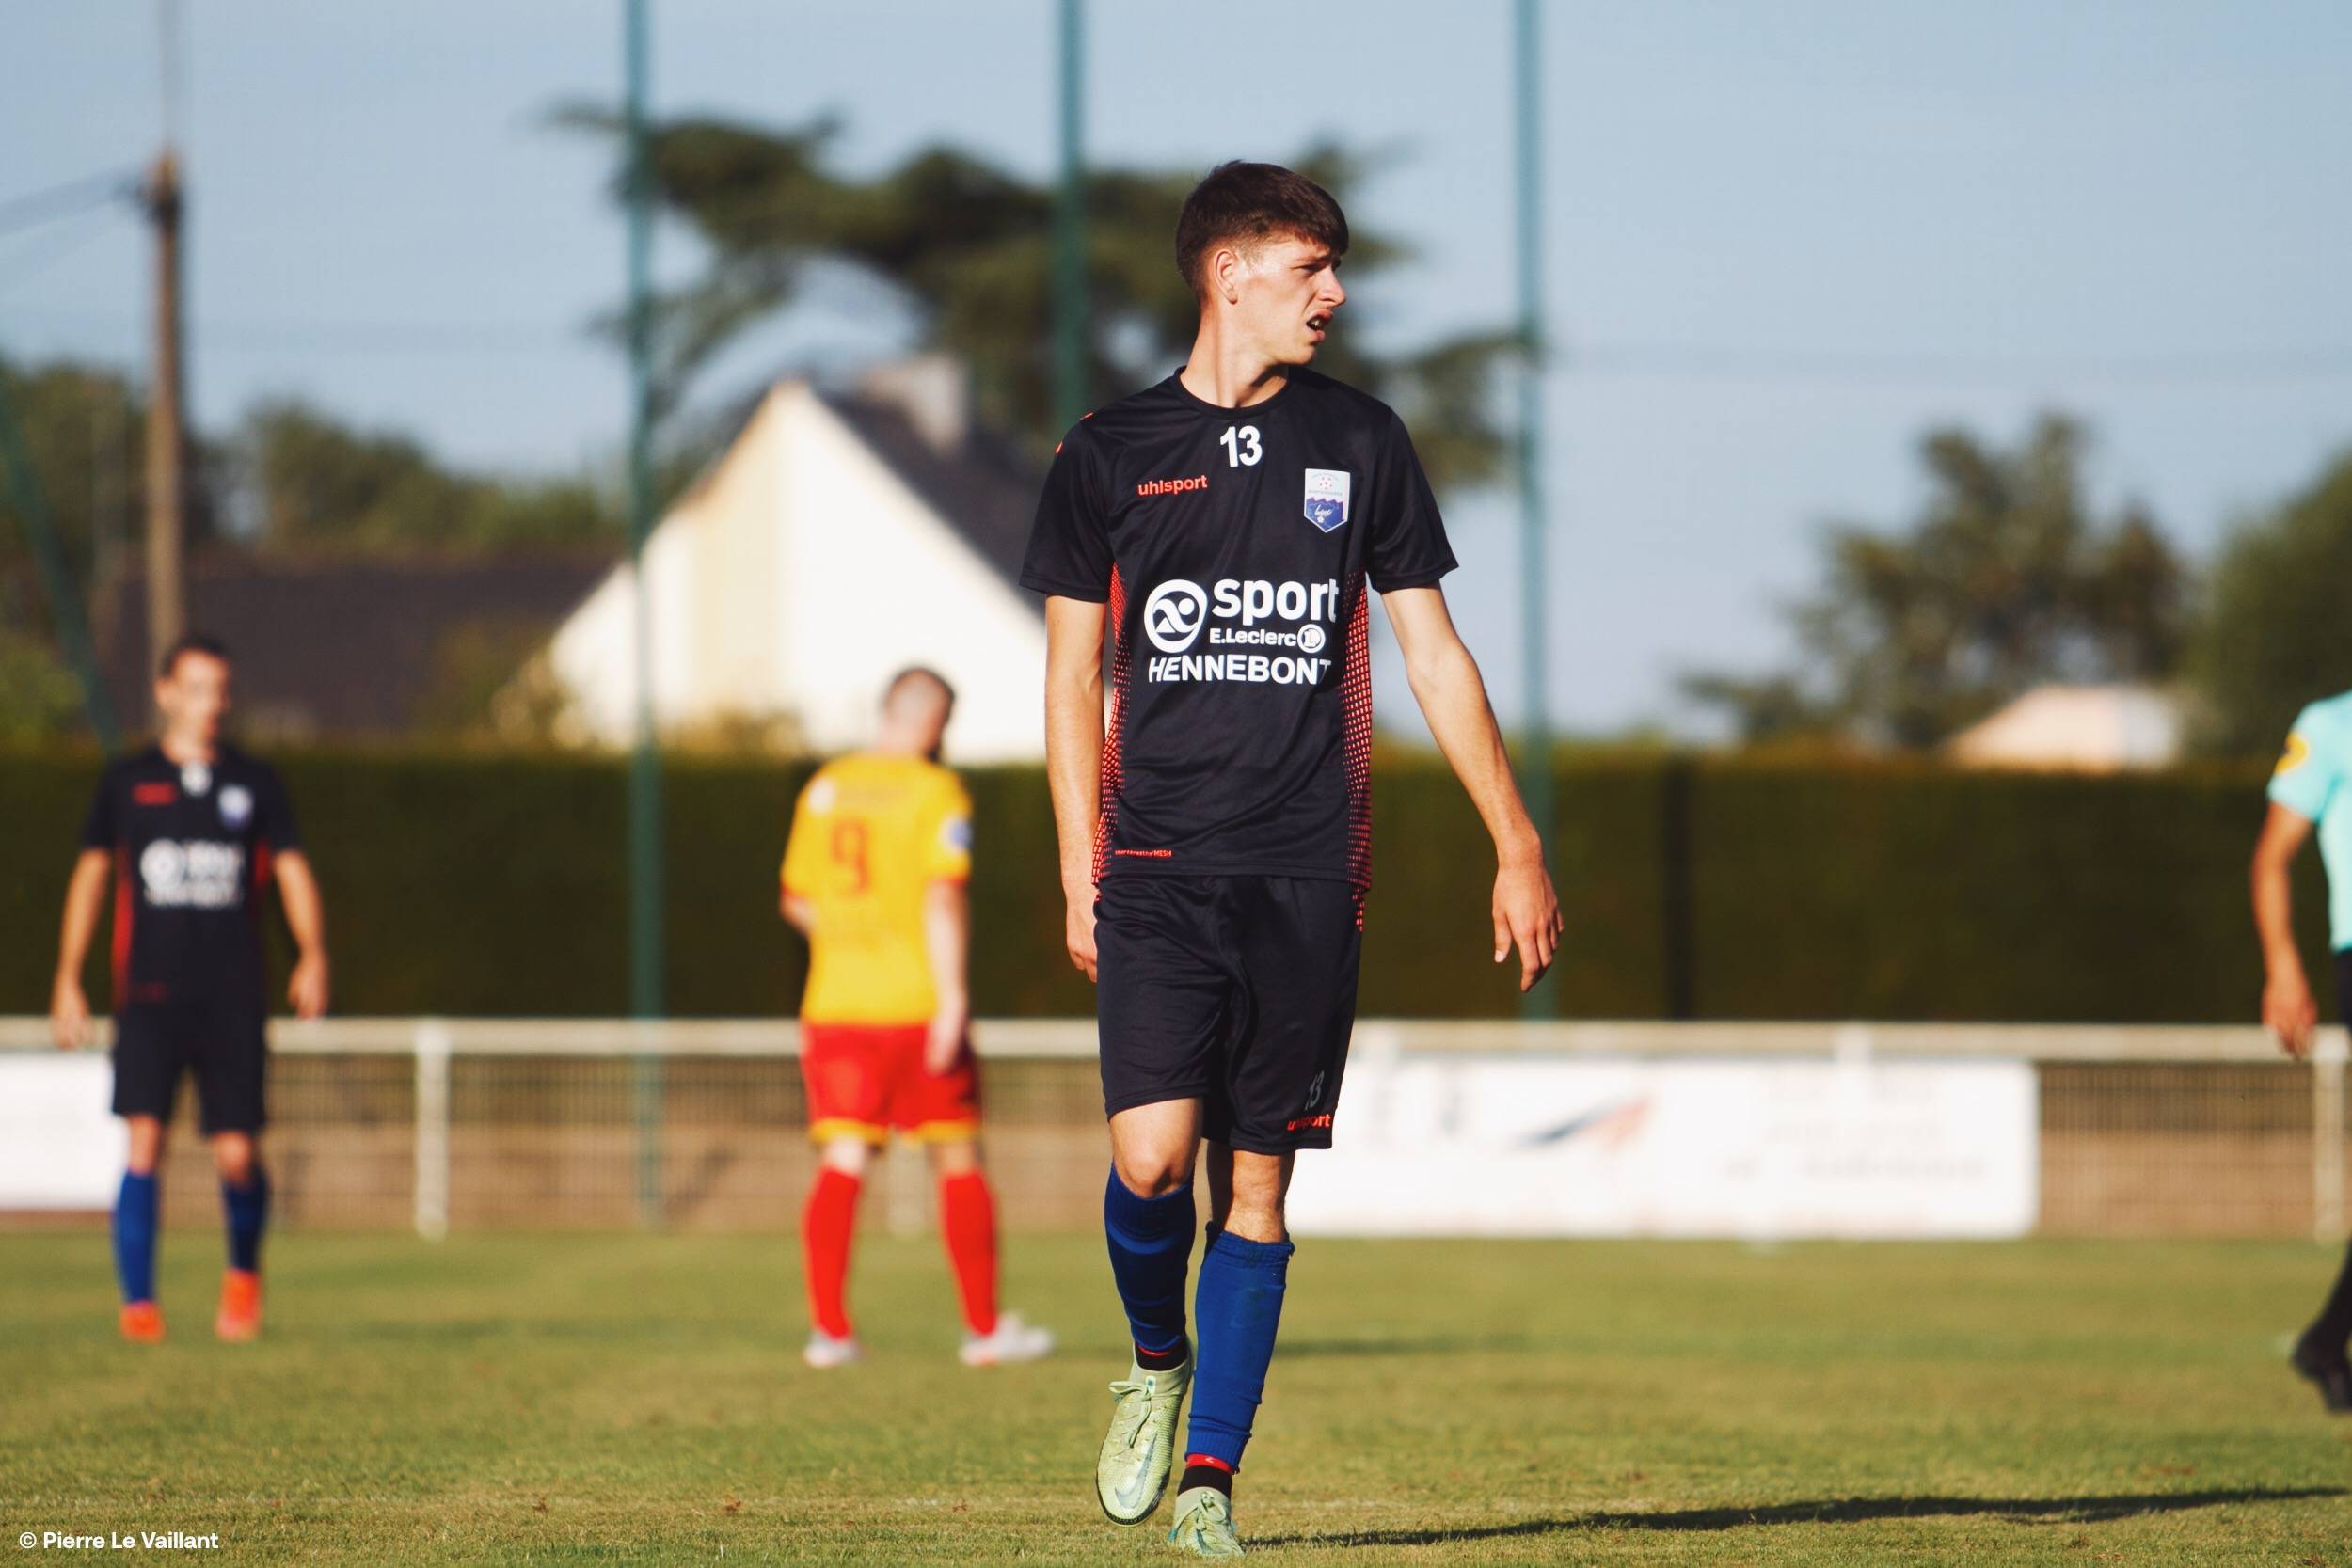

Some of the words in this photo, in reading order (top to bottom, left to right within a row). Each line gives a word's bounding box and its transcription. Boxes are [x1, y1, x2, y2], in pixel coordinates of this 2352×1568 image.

[1219, 425, 1263, 467] 13
[1137, 475, 1208, 496] uhlsport
[1212, 578, 1339, 626] sport
[1209, 627, 1297, 647] E.Leclerc
[830, 815, 870, 898] 9
